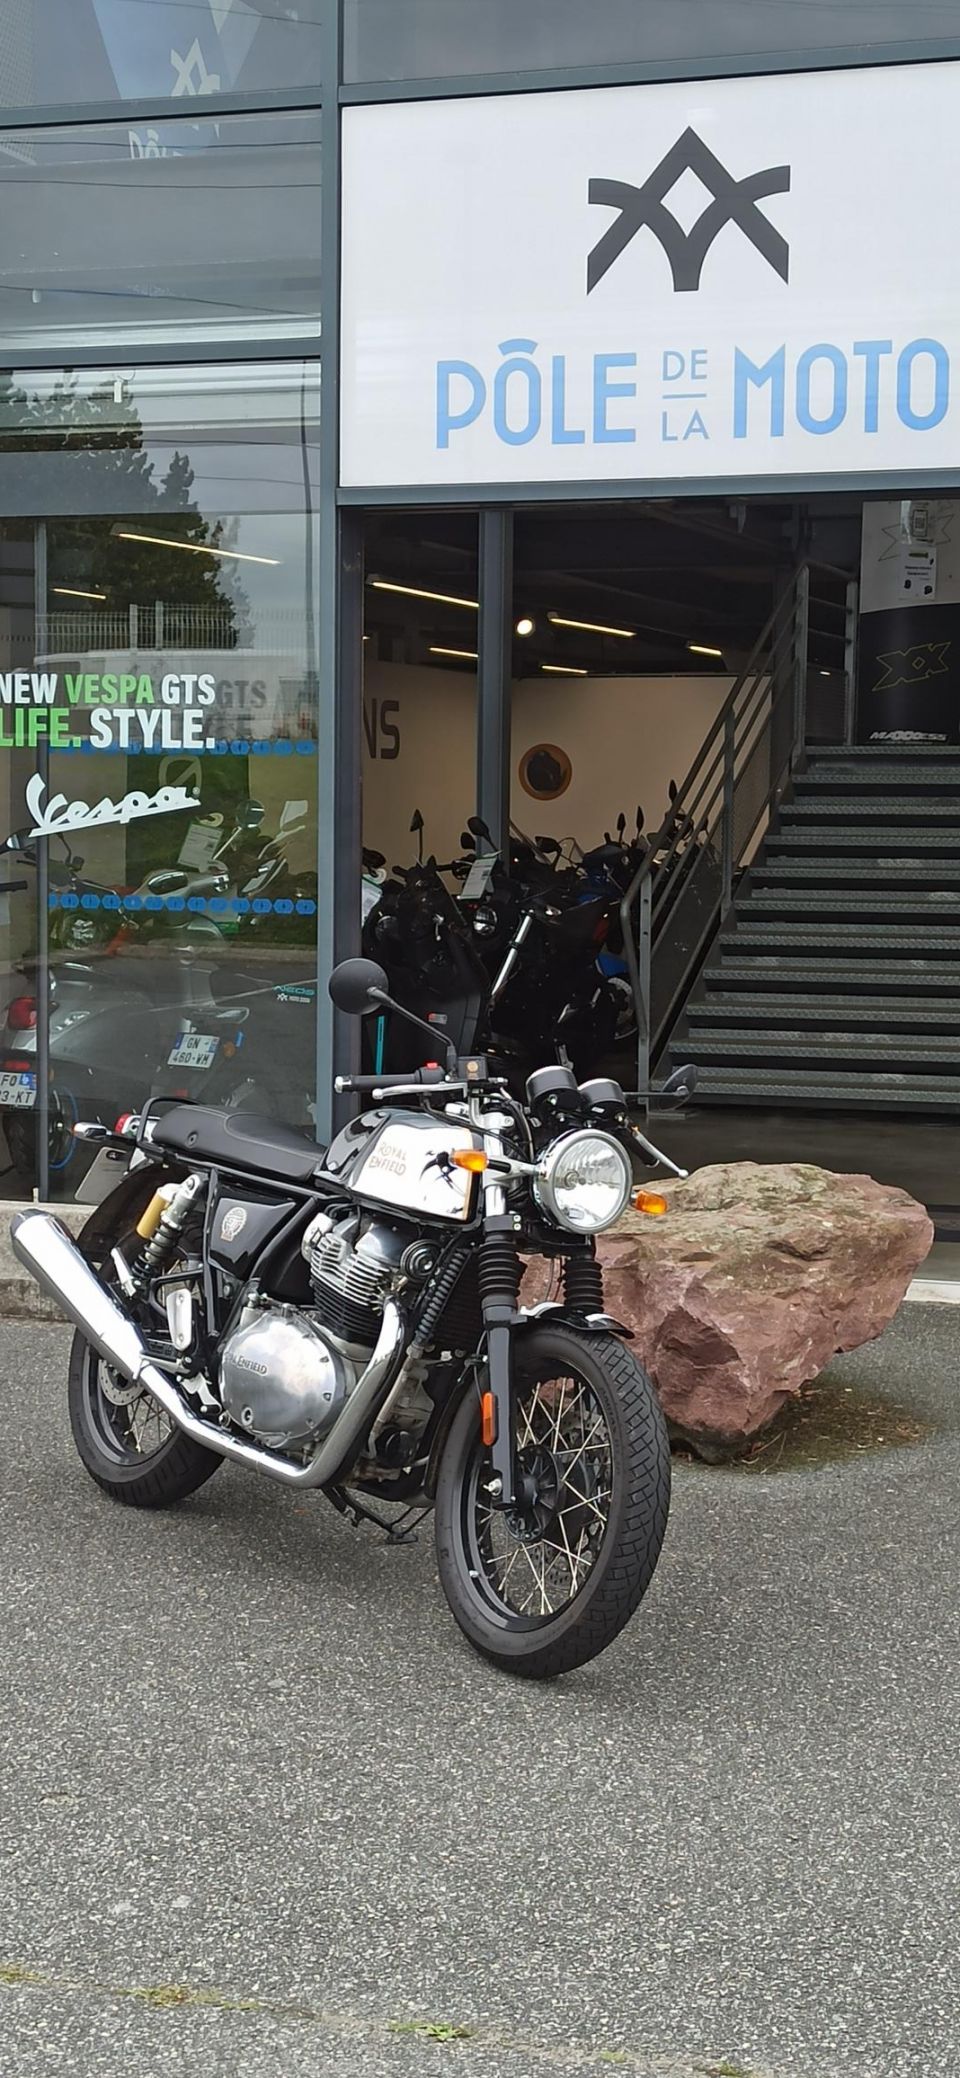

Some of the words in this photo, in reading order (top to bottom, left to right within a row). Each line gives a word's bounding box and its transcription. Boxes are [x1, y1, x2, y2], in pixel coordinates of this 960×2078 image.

[662, 349, 708, 381] DE
[436, 338, 637, 449] PÔLE
[733, 338, 950, 439] MOTO
[661, 409, 710, 442] LA
[0, 673, 57, 704] NEW
[64, 674, 155, 704] VESPA
[161, 674, 216, 705] GTS
[0, 708, 81, 747] LIFE.
[90, 708, 215, 749] STYLE.
[26, 773, 201, 838] Vespa
[0, 1090, 33, 1104] 3-KT
[368, 1155, 407, 1176] ENFIELD
[238, 1355, 268, 1376] ENFIELD
